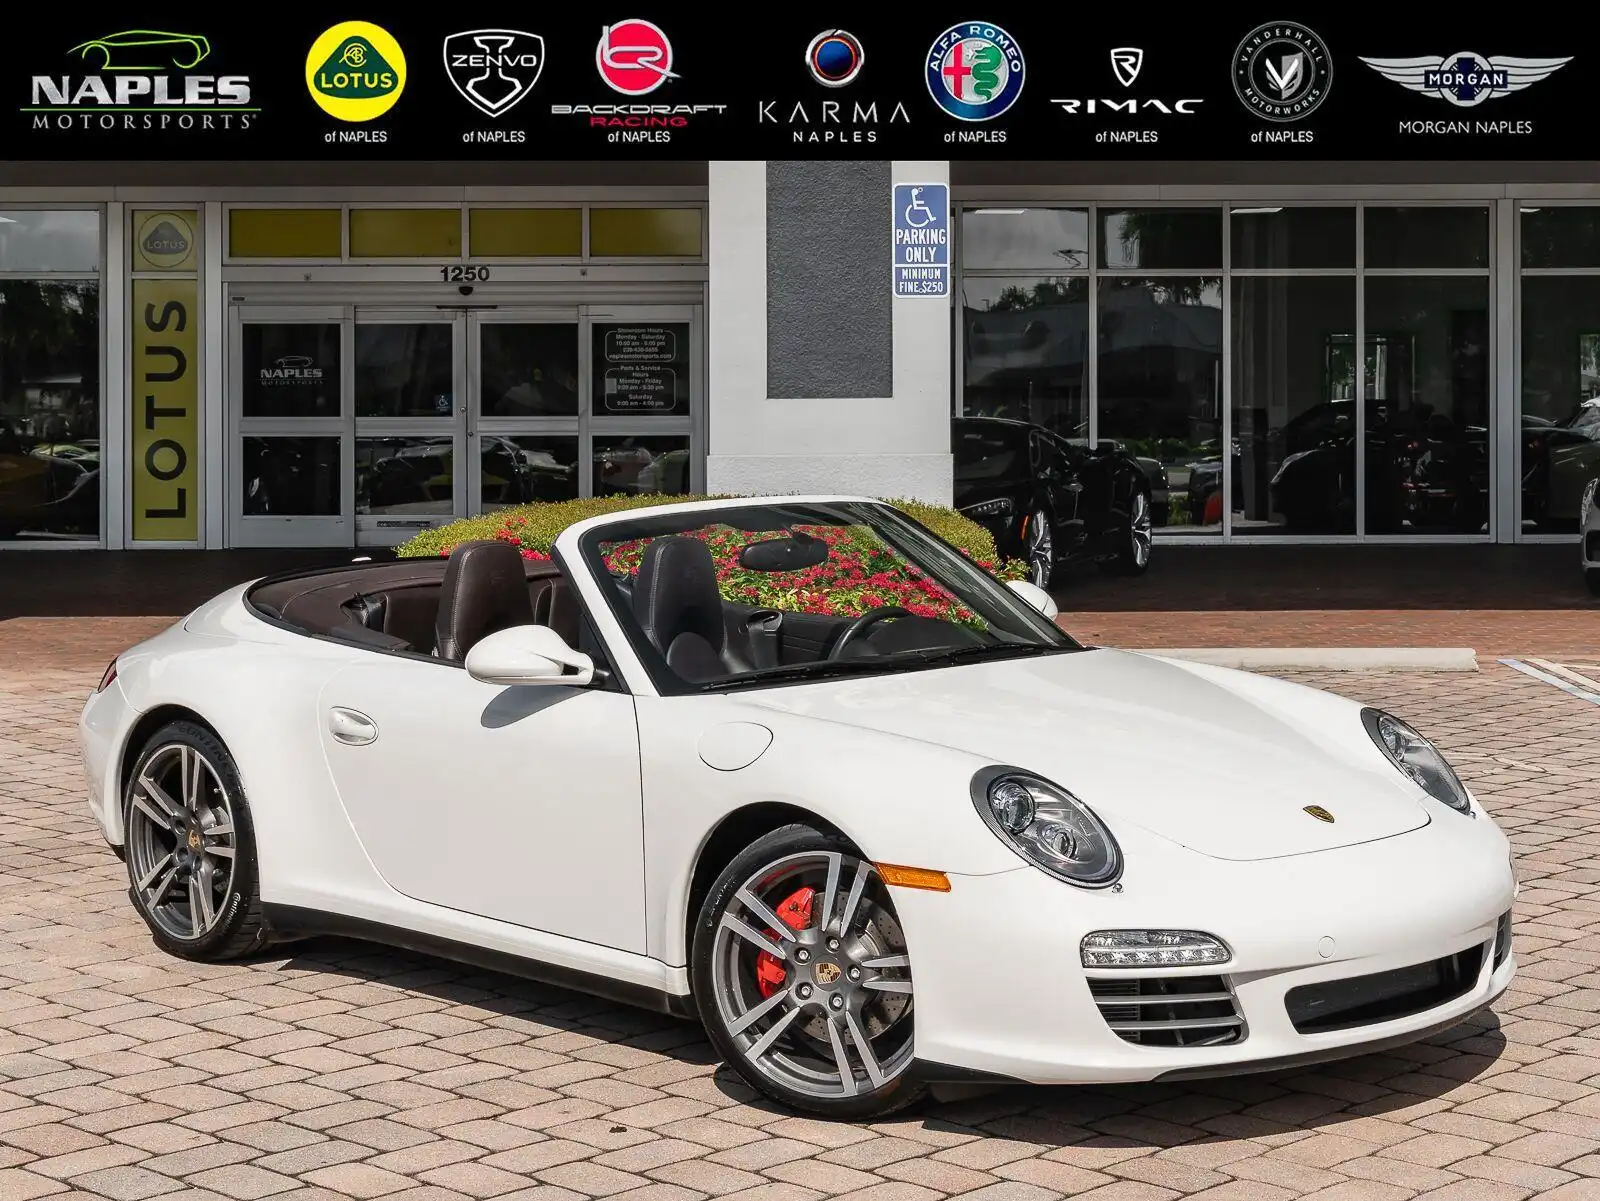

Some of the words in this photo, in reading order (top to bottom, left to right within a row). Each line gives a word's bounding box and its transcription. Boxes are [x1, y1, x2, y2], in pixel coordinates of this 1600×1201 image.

[896, 228, 946, 245] PARKING
[147, 240, 186, 249] LOTUS
[906, 246, 936, 262] ONLY
[440, 266, 490, 282] 1250
[902, 268, 940, 280] MINIMUM
[900, 282, 920, 292] FINE
[922, 280, 944, 294] $250
[260, 368, 322, 378] NAPLES
[144, 300, 188, 519] LOTUS
